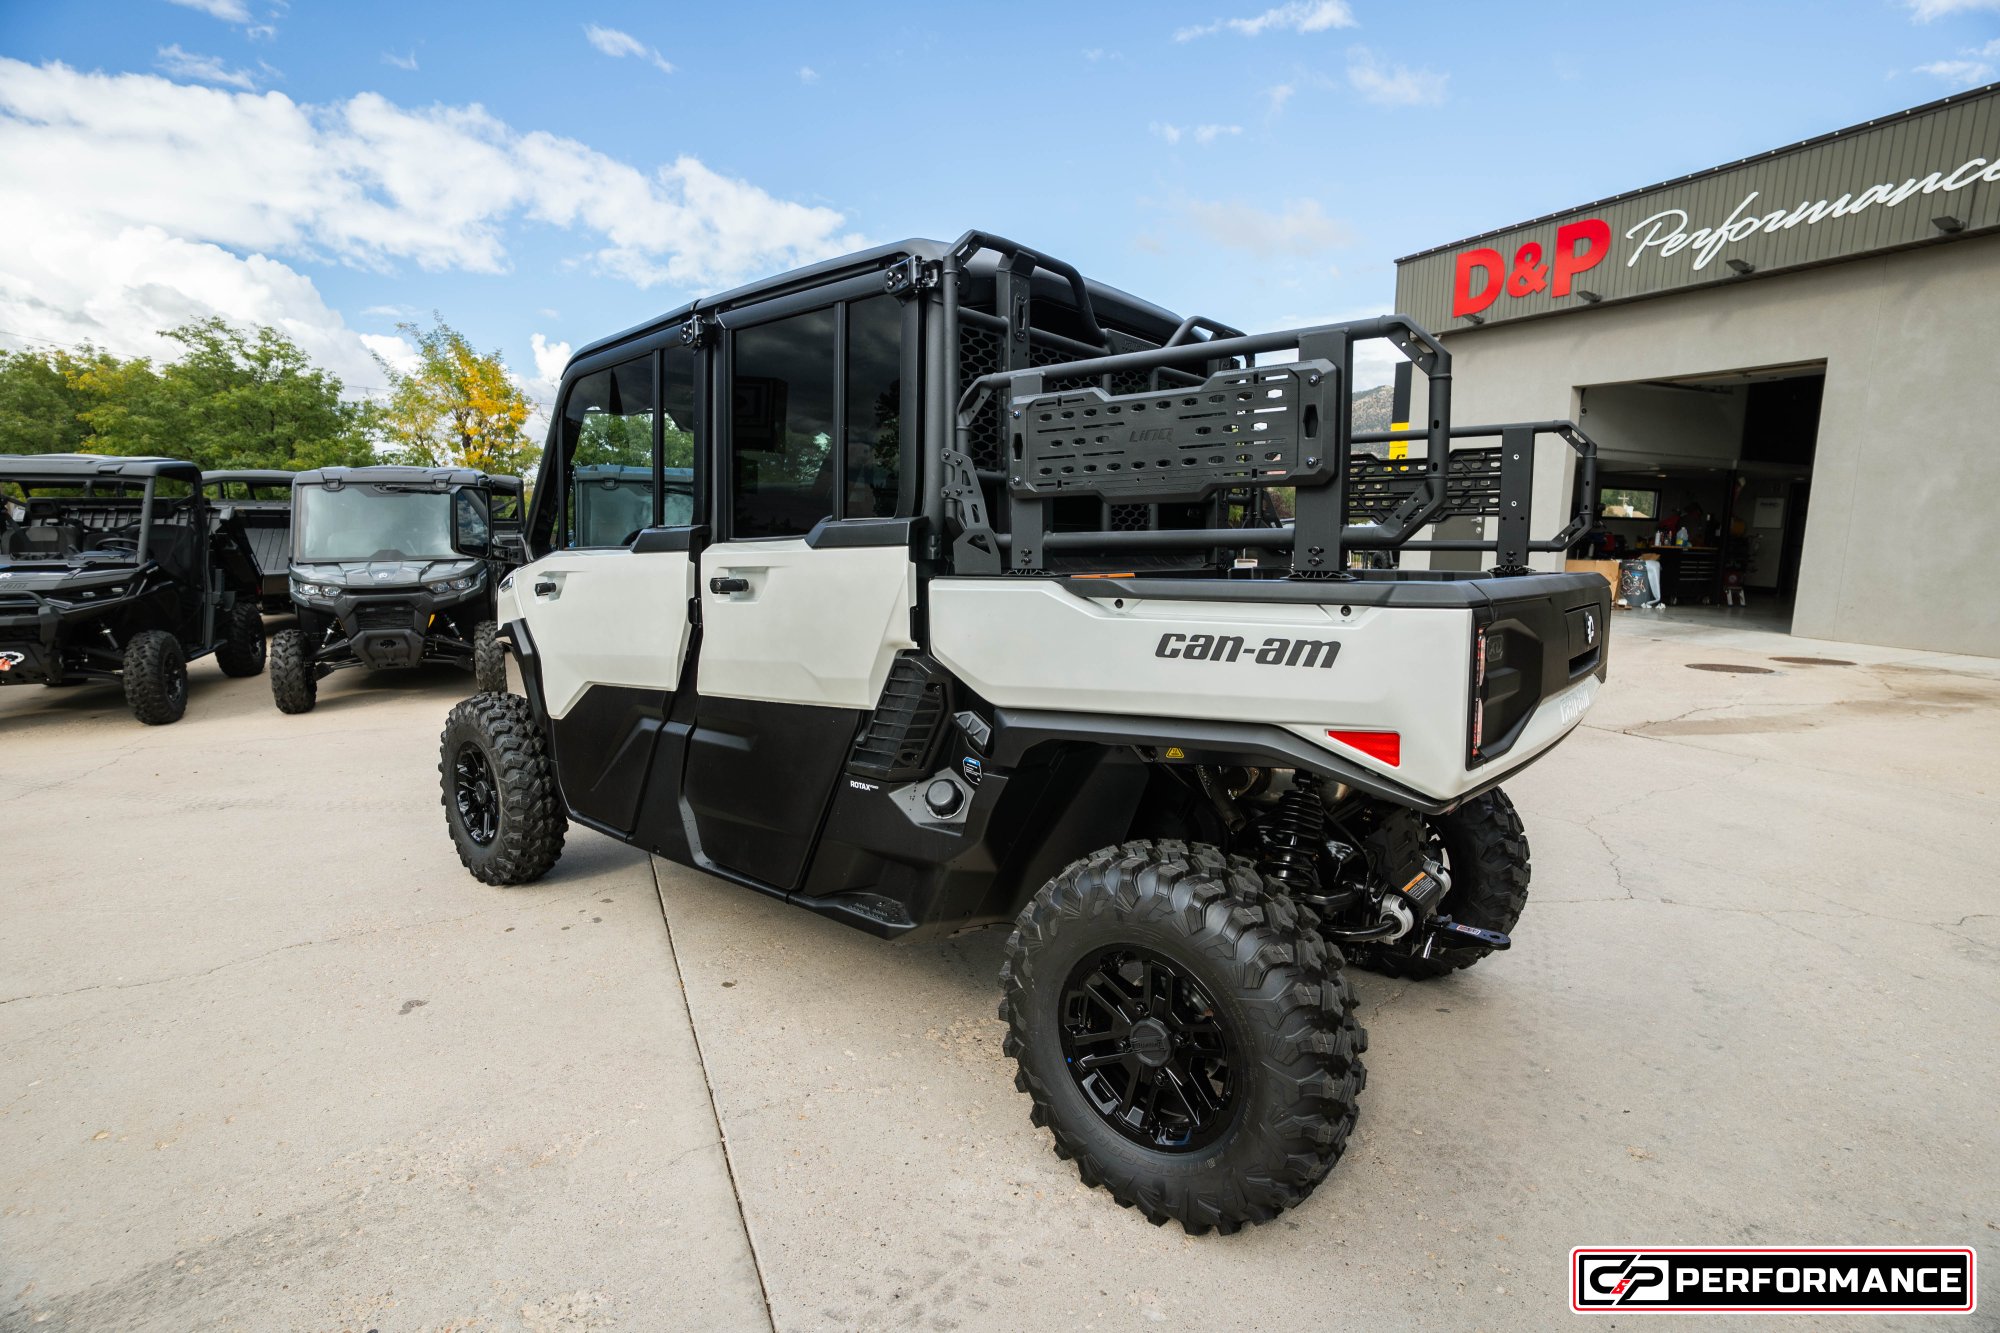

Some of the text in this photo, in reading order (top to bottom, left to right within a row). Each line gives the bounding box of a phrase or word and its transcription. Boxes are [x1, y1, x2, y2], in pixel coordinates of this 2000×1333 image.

[1453, 218, 1611, 319] D&P
[1155, 633, 1342, 669] can-am
[850, 780, 871, 791] ROTAX
